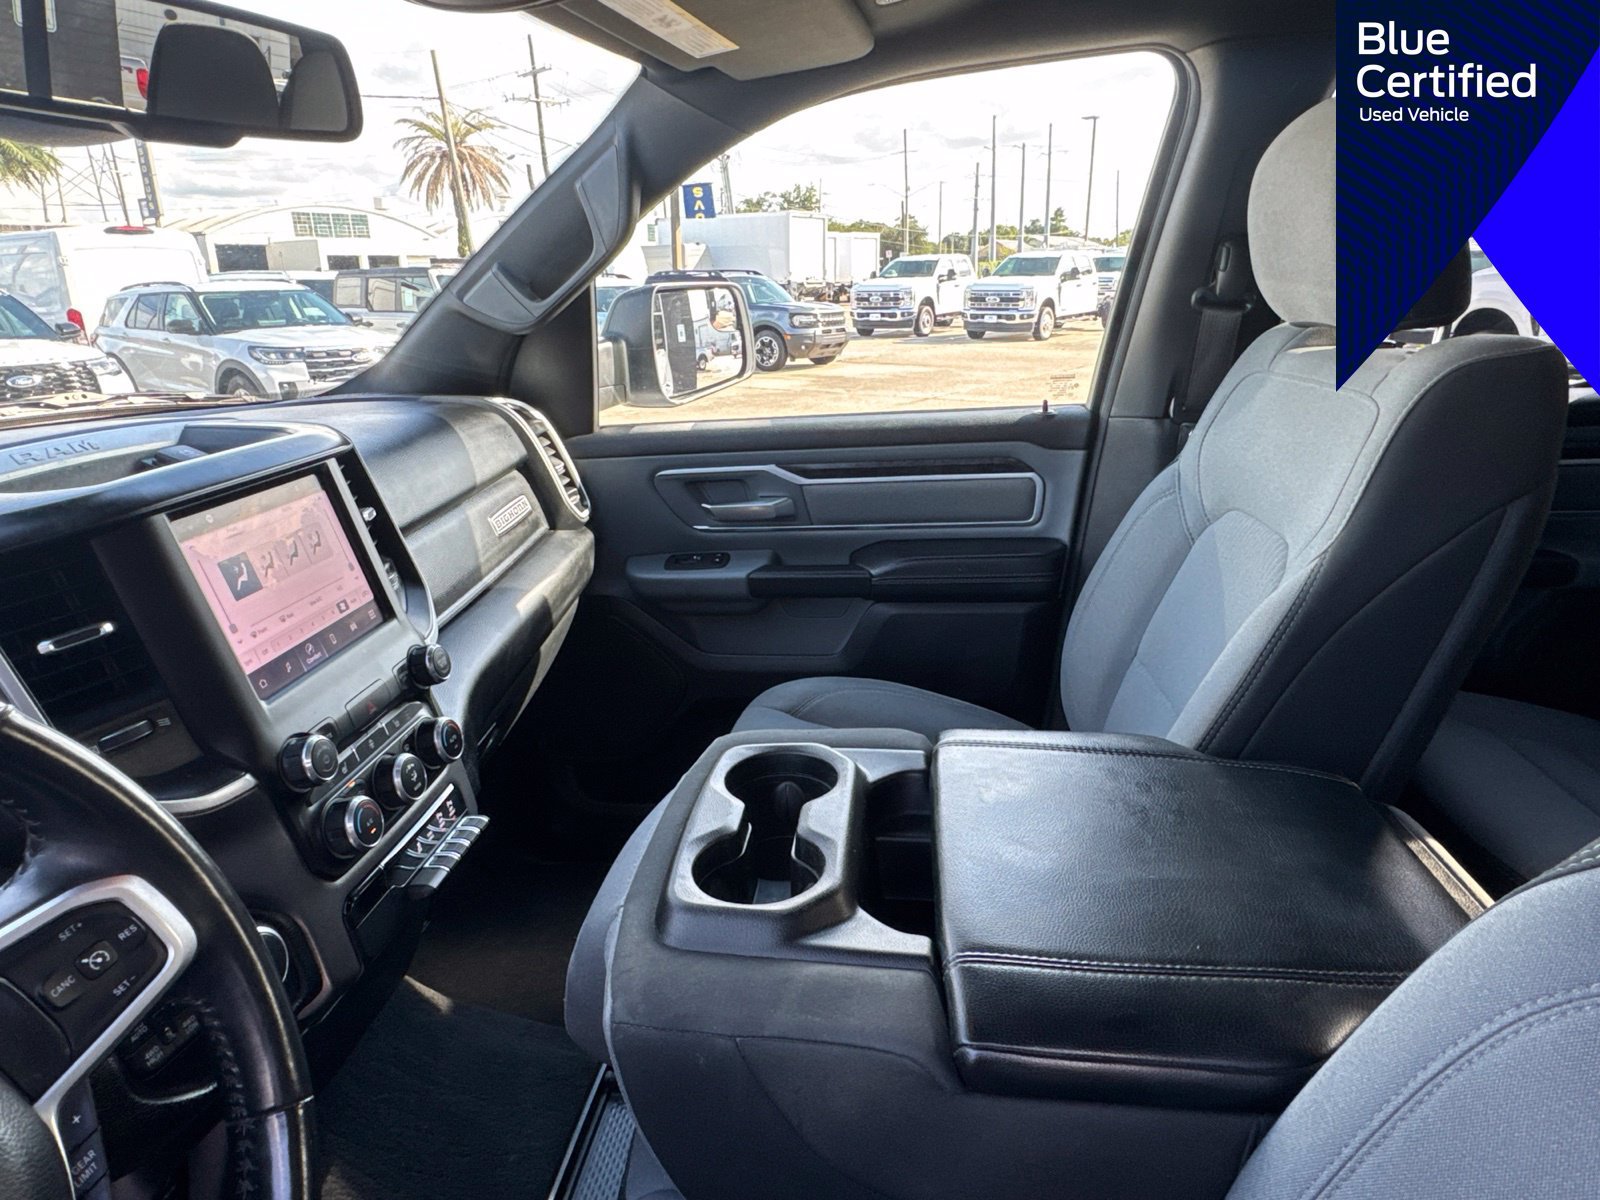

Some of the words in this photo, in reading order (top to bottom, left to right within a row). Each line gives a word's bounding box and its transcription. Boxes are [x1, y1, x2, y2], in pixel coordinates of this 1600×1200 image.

[8, 439, 101, 466] RAM
[117, 923, 138, 941] RES
[50, 974, 76, 998] CANC
[71, 1149, 97, 1176] GEAR
[74, 1161, 98, 1188] LIMIT
